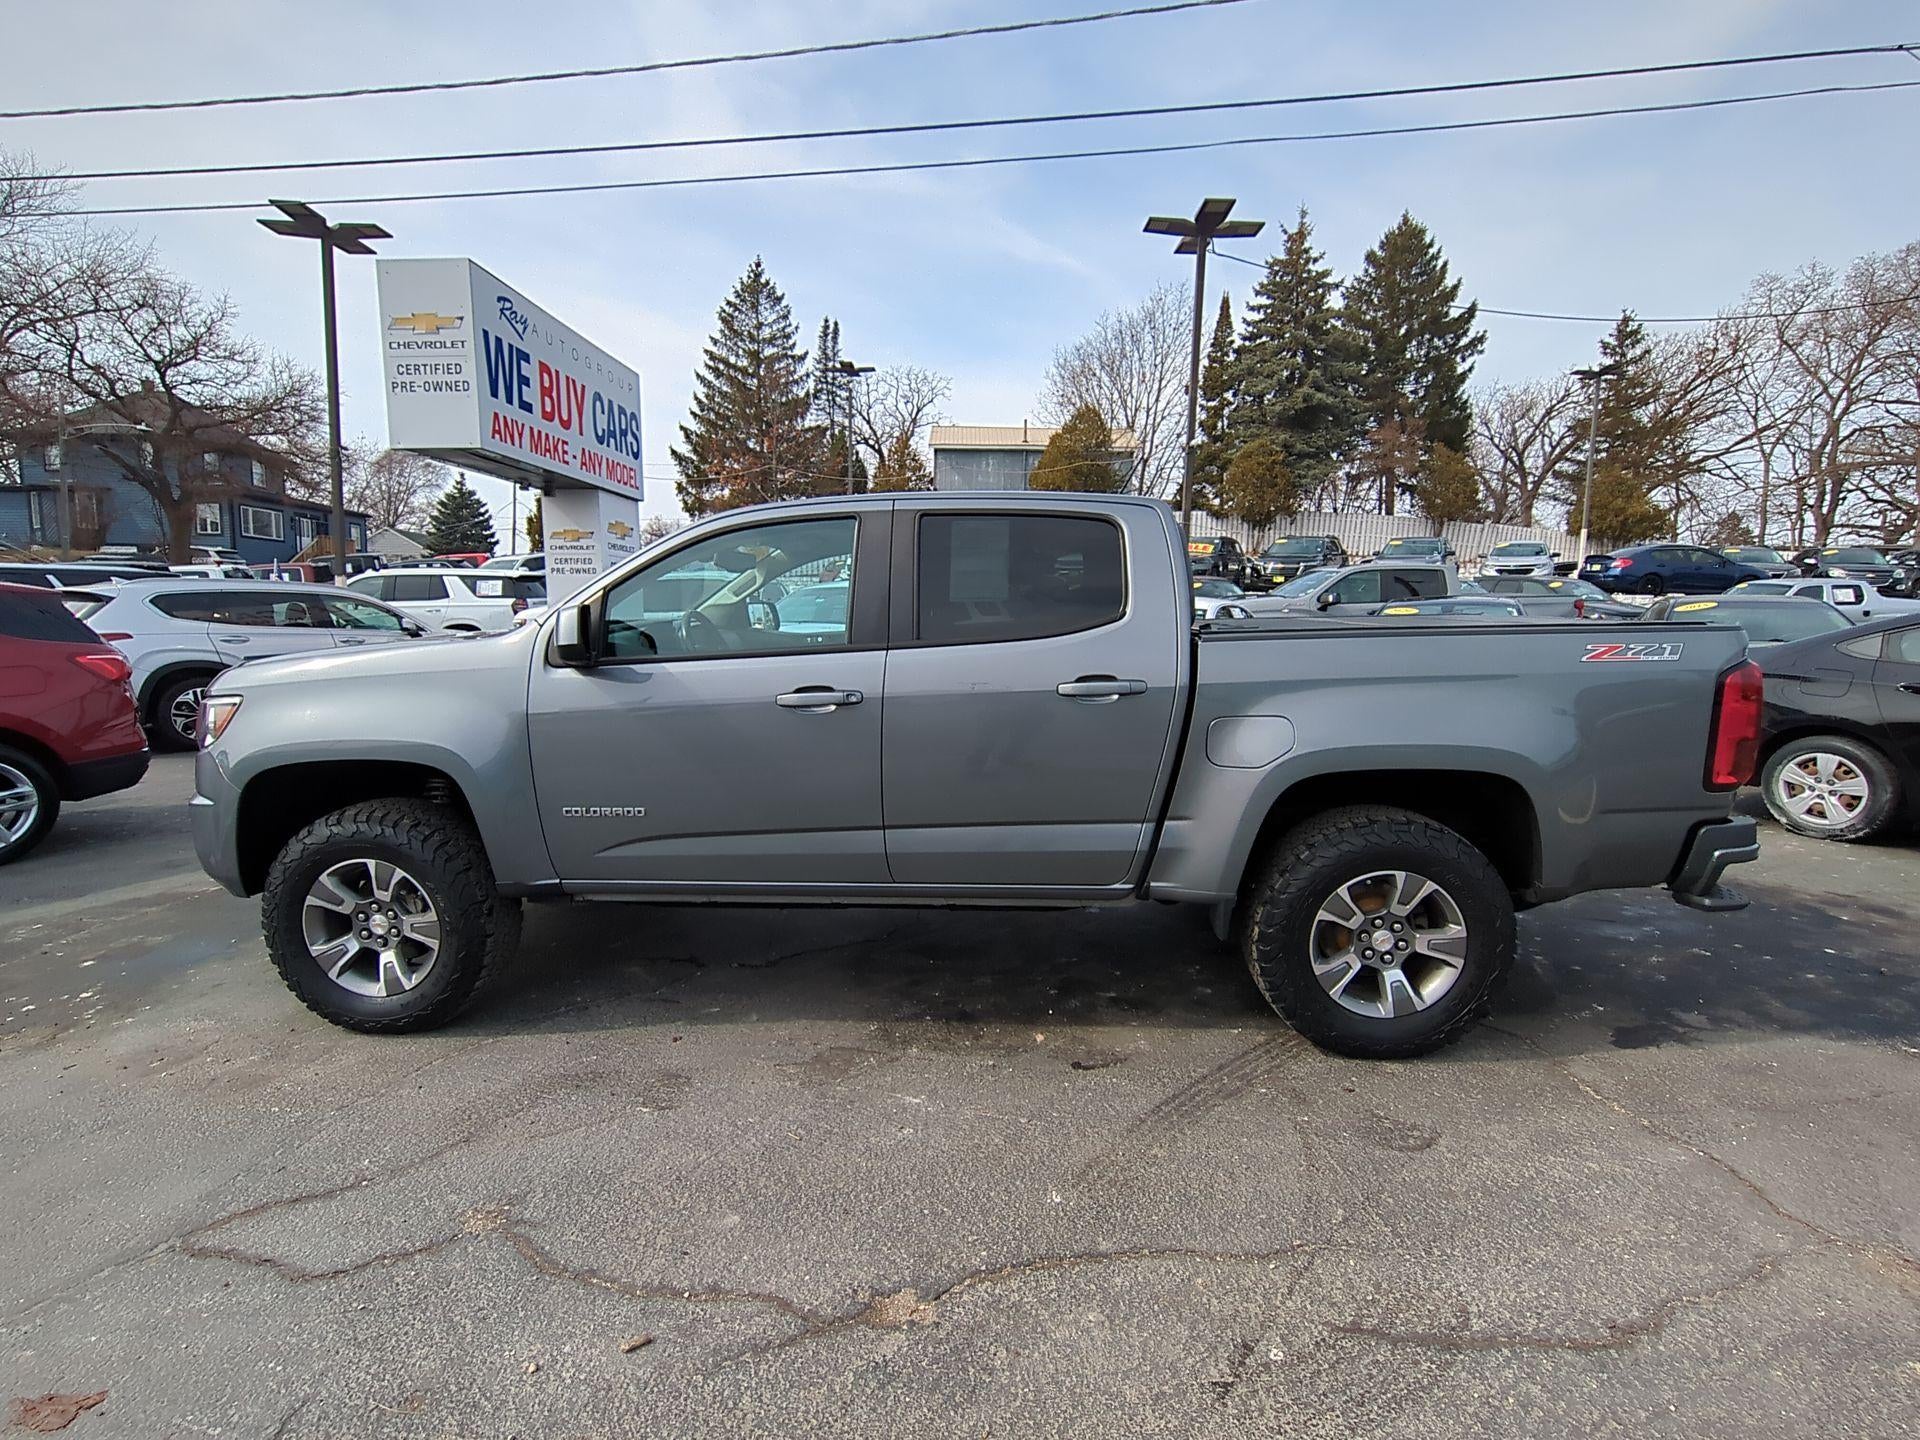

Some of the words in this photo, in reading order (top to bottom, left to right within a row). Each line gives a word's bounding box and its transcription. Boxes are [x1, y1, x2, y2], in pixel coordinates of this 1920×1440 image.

[496, 296, 528, 341] Ray
[389, 340, 467, 350] CHEVROLET
[396, 363, 462, 375] CERTIFIED
[391, 380, 470, 393] PRE-OWNED
[482, 328, 533, 415] WE
[538, 360, 585, 436] BUY
[592, 390, 640, 461] CARS
[491, 411, 525, 449] ANY
[529, 426, 569, 466] MAKE
[580, 447, 603, 478] ANY
[606, 457, 639, 490] MODEL
[554, 557, 593, 565] CERTIFIED
[550, 567, 597, 575] PRE-OWNED
[1581, 643, 1684, 662] Z71
[562, 807, 646, 817] COLORADO
